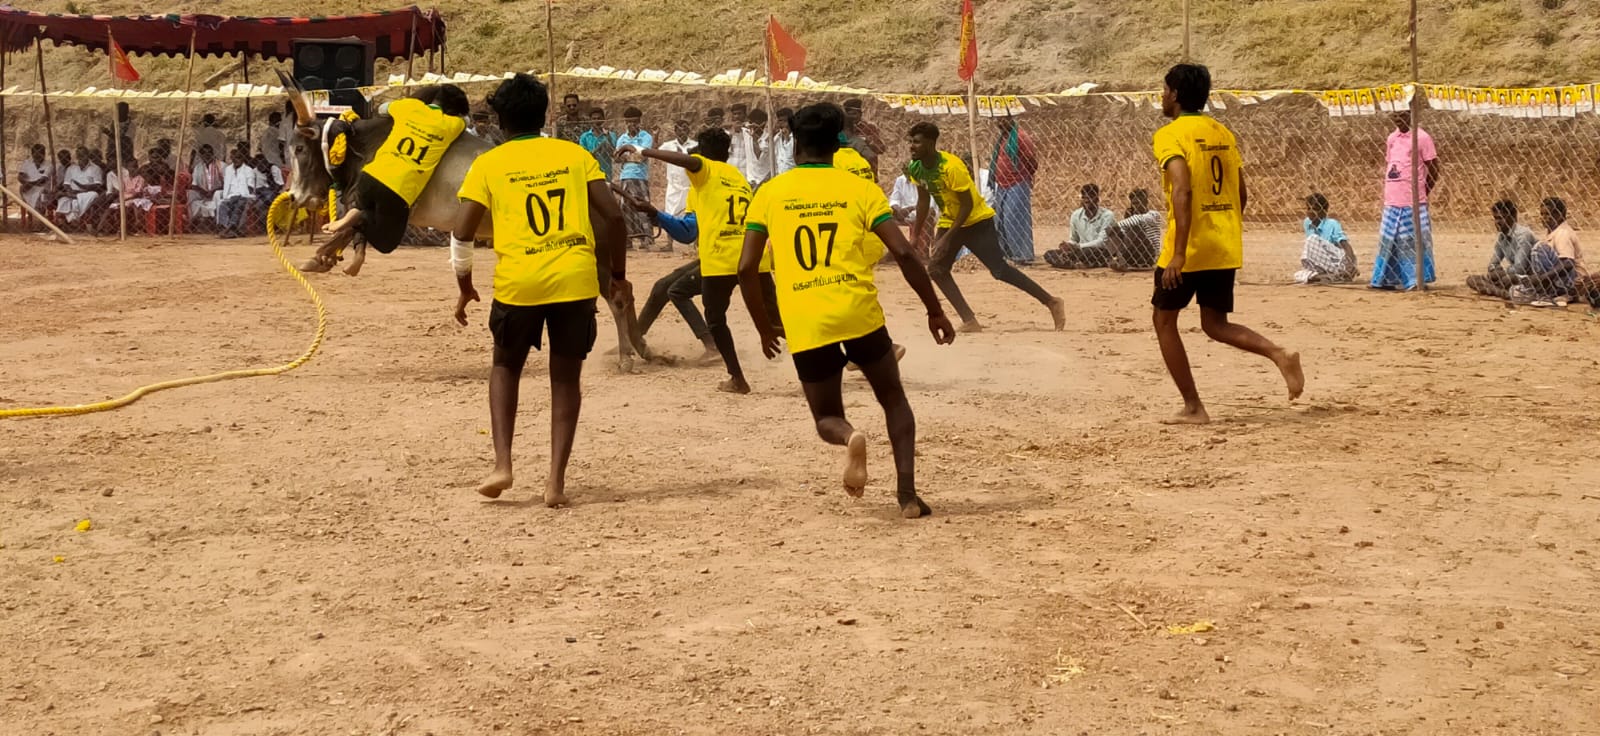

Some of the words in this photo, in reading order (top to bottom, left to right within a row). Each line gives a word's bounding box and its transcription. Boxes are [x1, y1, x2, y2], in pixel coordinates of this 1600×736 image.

[397, 137, 429, 165] 01
[1211, 155, 1223, 196] 9
[526, 188, 566, 237] 07
[726, 194, 750, 225] 17
[794, 222, 838, 271] 07
